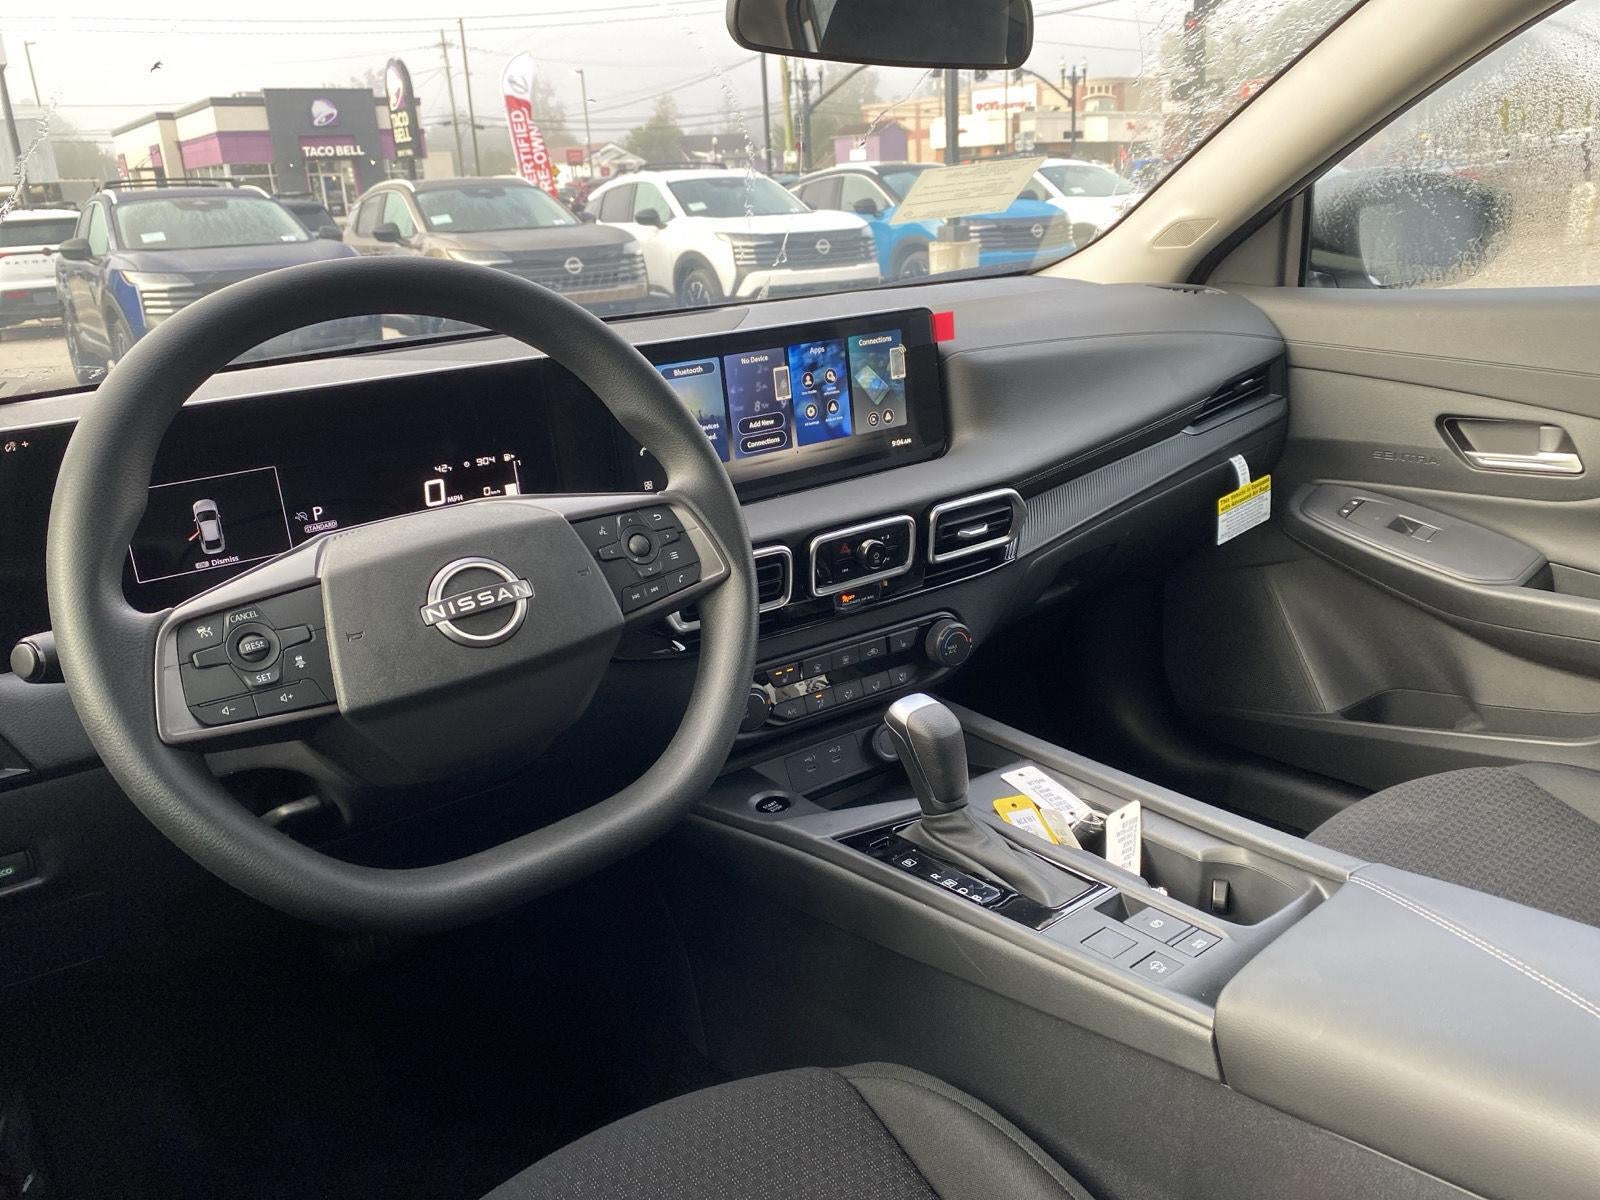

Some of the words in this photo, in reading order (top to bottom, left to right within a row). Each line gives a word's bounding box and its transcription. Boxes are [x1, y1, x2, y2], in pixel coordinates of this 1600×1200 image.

[391, 111, 409, 127] TACO
[394, 127, 412, 143] BELL
[302, 146, 334, 157] TACO
[335, 145, 365, 156] BELL
[511, 110, 538, 184] ERTIFIED
[859, 336, 892, 346] Connections
[809, 347, 825, 355] Apps
[750, 355, 769, 363] Device
[673, 366, 703, 376] Bluetooth
[754, 401, 761, 412] 8
[747, 436, 780, 448] Connections
[424, 478, 446, 507] 0
[447, 494, 463, 503] MPH
[483, 486, 491, 496] 0
[313, 506, 322, 521] P
[305, 522, 336, 532] STANDARD
[211, 555, 239, 567] Dismiss
[426, 583, 531, 621] NISSAN
[230, 610, 259, 623] CANCEL
[256, 673, 272, 683] SET
[787, 708, 798, 716] A/C
[763, 800, 777, 809] START
[930, 872, 941, 880] R
[960, 887, 969, 895] D
